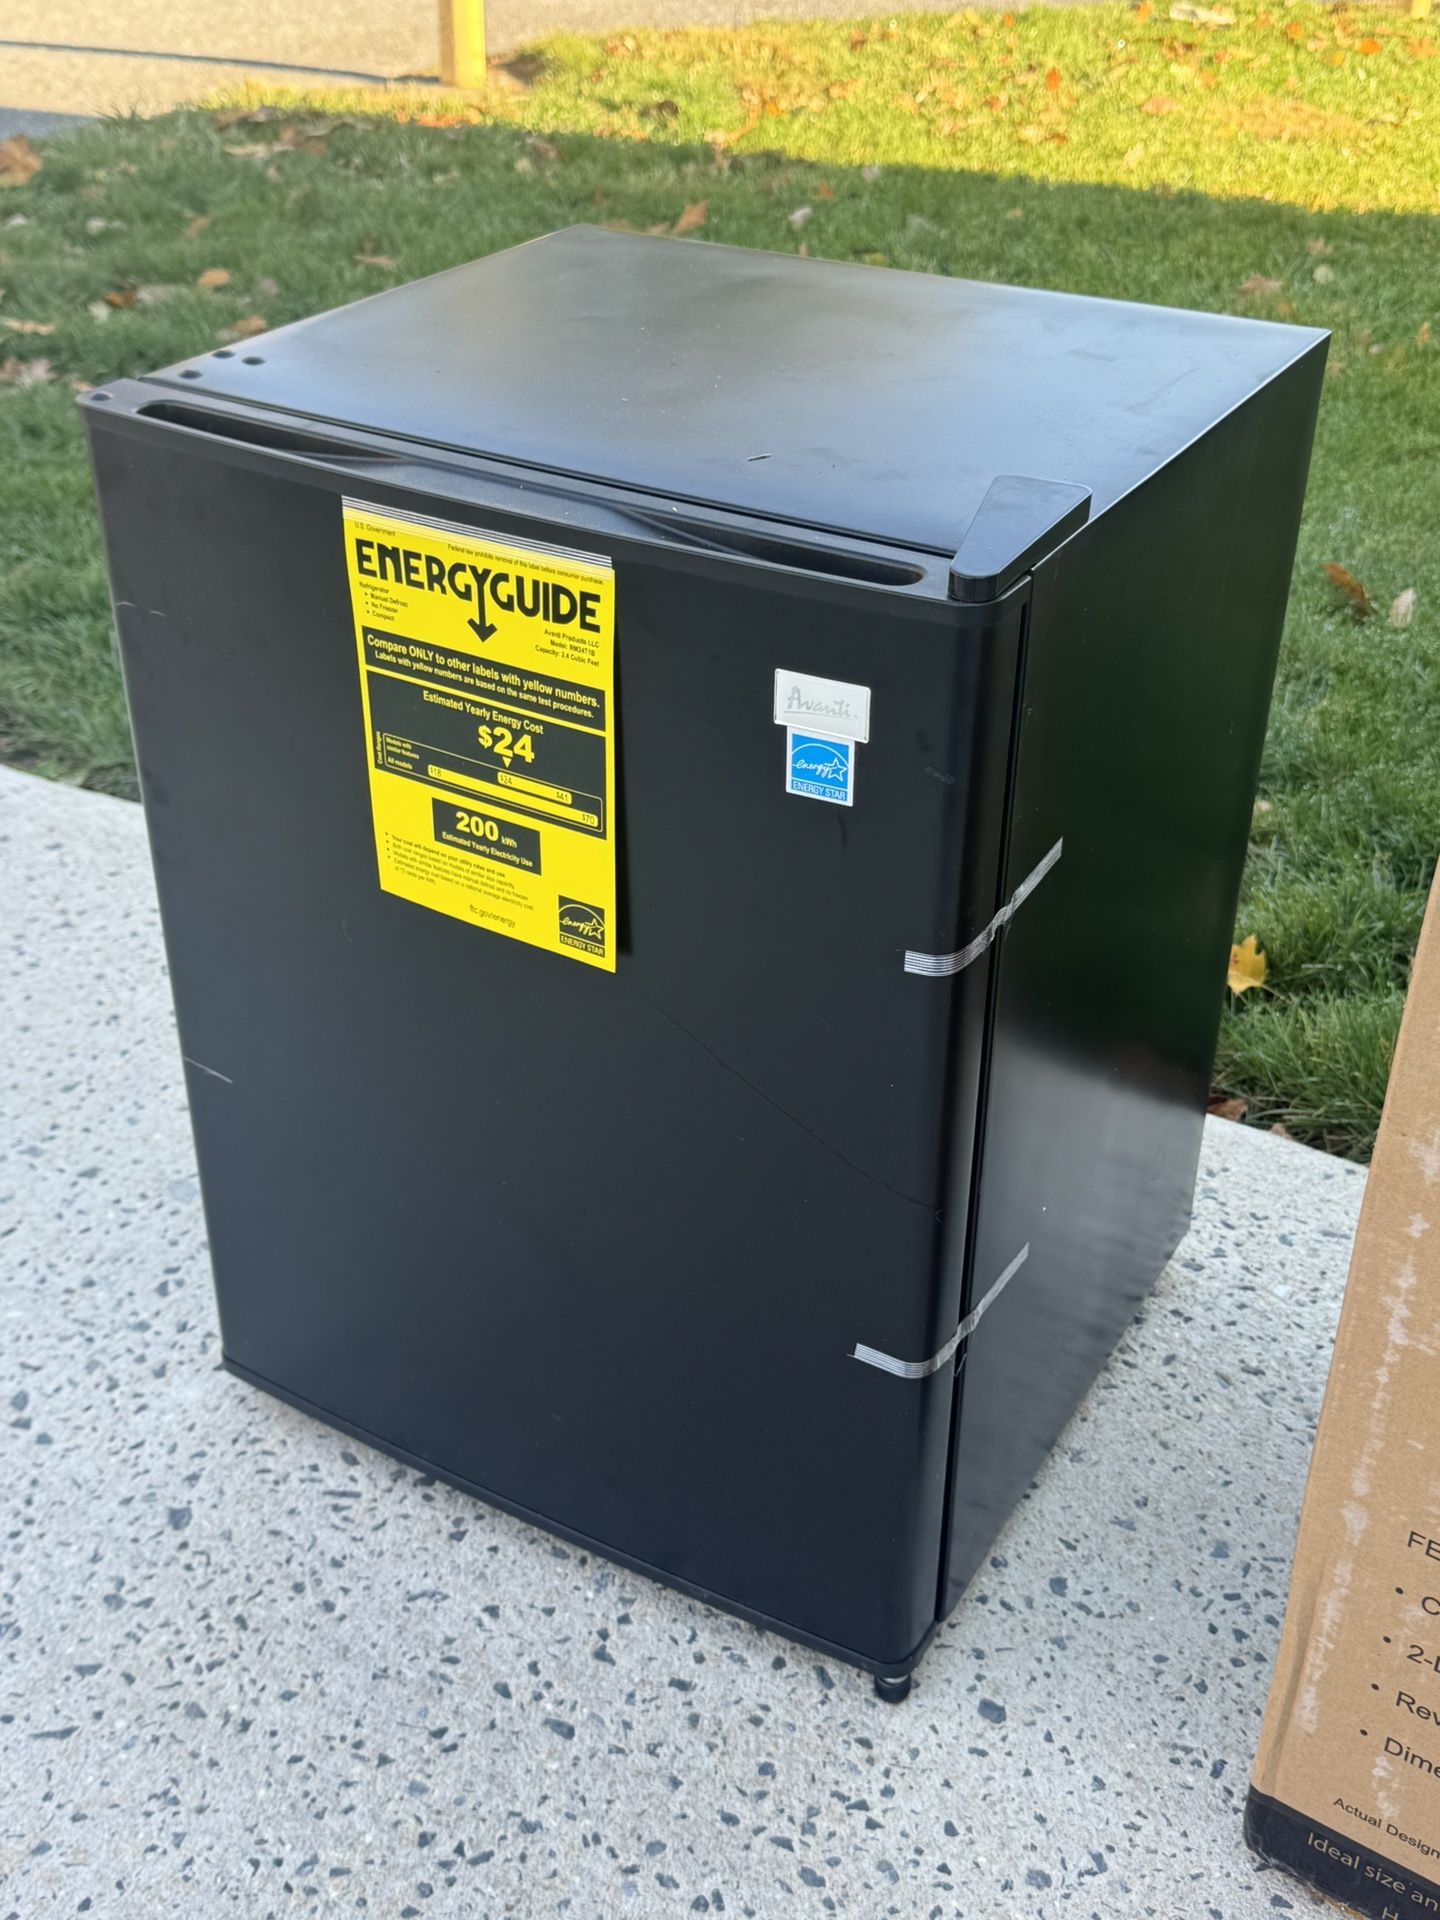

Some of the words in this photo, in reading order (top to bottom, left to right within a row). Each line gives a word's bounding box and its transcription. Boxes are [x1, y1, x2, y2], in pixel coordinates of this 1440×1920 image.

[354, 521, 364, 530] U.S.
[366, 525, 396, 537] Government
[355, 538, 601, 642] ENERGYGUIDE
[372, 610, 395, 621] Compact
[380, 603, 398, 613] Freezer
[544, 628, 561, 638] Avanti
[562, 633, 587, 645] Products
[588, 640, 600, 648] LLC
[367, 633, 408, 655] Compare
[409, 645, 434, 662] ONLY
[435, 652, 445, 665] to
[447, 657, 471, 673] other
[472, 663, 500, 681] labels
[501, 672, 521, 687] with
[523, 678, 553, 696] yellow
[555, 687, 600, 709] numbers.
[535, 644, 560, 658] Capacity:
[571, 654, 586, 665] Cubic
[587, 657, 600, 667] Feet
[375, 649, 397, 663] Labels
[397, 657, 412, 668] with
[412, 660, 433, 673] yellow
[434, 667, 462, 682] numbers
[464, 676, 475, 685] are
[475, 679, 496, 692] based
[497, 685, 506, 693] on
[506, 687, 518, 698] the
[519, 691, 537, 704] same
[538, 696, 552, 707] test
[552, 700, 595, 718] procedures.
[423, 690, 464, 711] Estimated
[464, 702, 490, 721] Yearly
[492, 709, 522, 731] Energy
[523, 719, 544, 735] Cost
[784, 685, 853, 719] Avanti
[477, 724, 535, 764] $24
[429, 766, 442, 778] $18
[792, 780, 824, 798] ENERGY
[825, 787, 847, 801] STAR
[455, 811, 499, 842] 200
[501, 835, 518, 849] kWh
[582, 813, 595, 826] $70
[442, 831, 472, 848] Estimated
[472, 841, 490, 855] Yearly
[490, 847, 520, 864] Electricity
[521, 857, 534, 868] Use
[560, 935, 587, 951] ENERGY
[586, 942, 605, 956] STAR
[1333, 1798, 1382, 1829] Actual
[1307, 1832, 1360, 1870] Ideal
[1364, 1865, 1406, 1894] size
[1411, 1890, 1440, 1912] an
